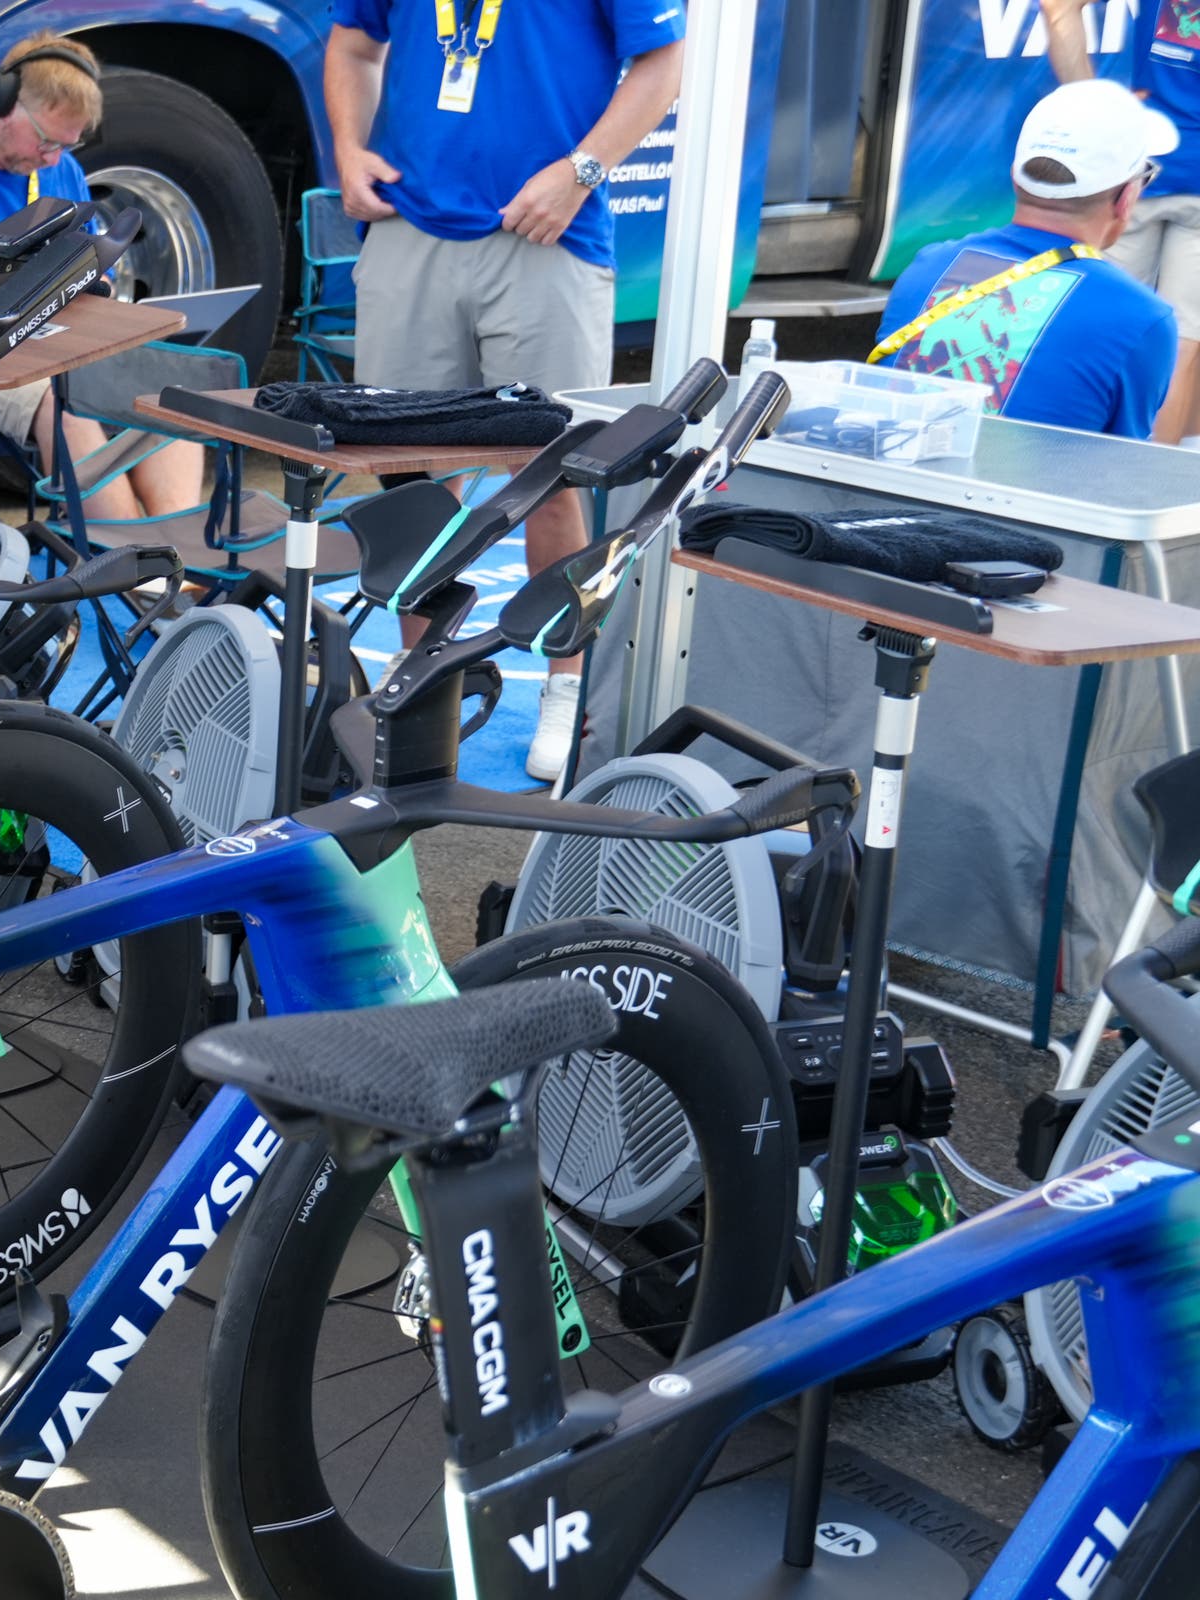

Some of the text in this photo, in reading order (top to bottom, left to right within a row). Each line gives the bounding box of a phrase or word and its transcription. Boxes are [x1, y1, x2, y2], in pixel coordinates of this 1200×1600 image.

[638, 197, 664, 212] Paul
[17, 268, 97, 341] SWISS SIDE Deda
[550, 940, 601, 958] GRAND
[600, 939, 634, 949] PRIX
[634, 940, 673, 957] 5000
[608, 965, 673, 1020] SIDE
[859, 1143, 893, 1156] WER
[14, 1114, 285, 1479] VAN RYSE
[462, 1228, 510, 1417] CMA CGM
